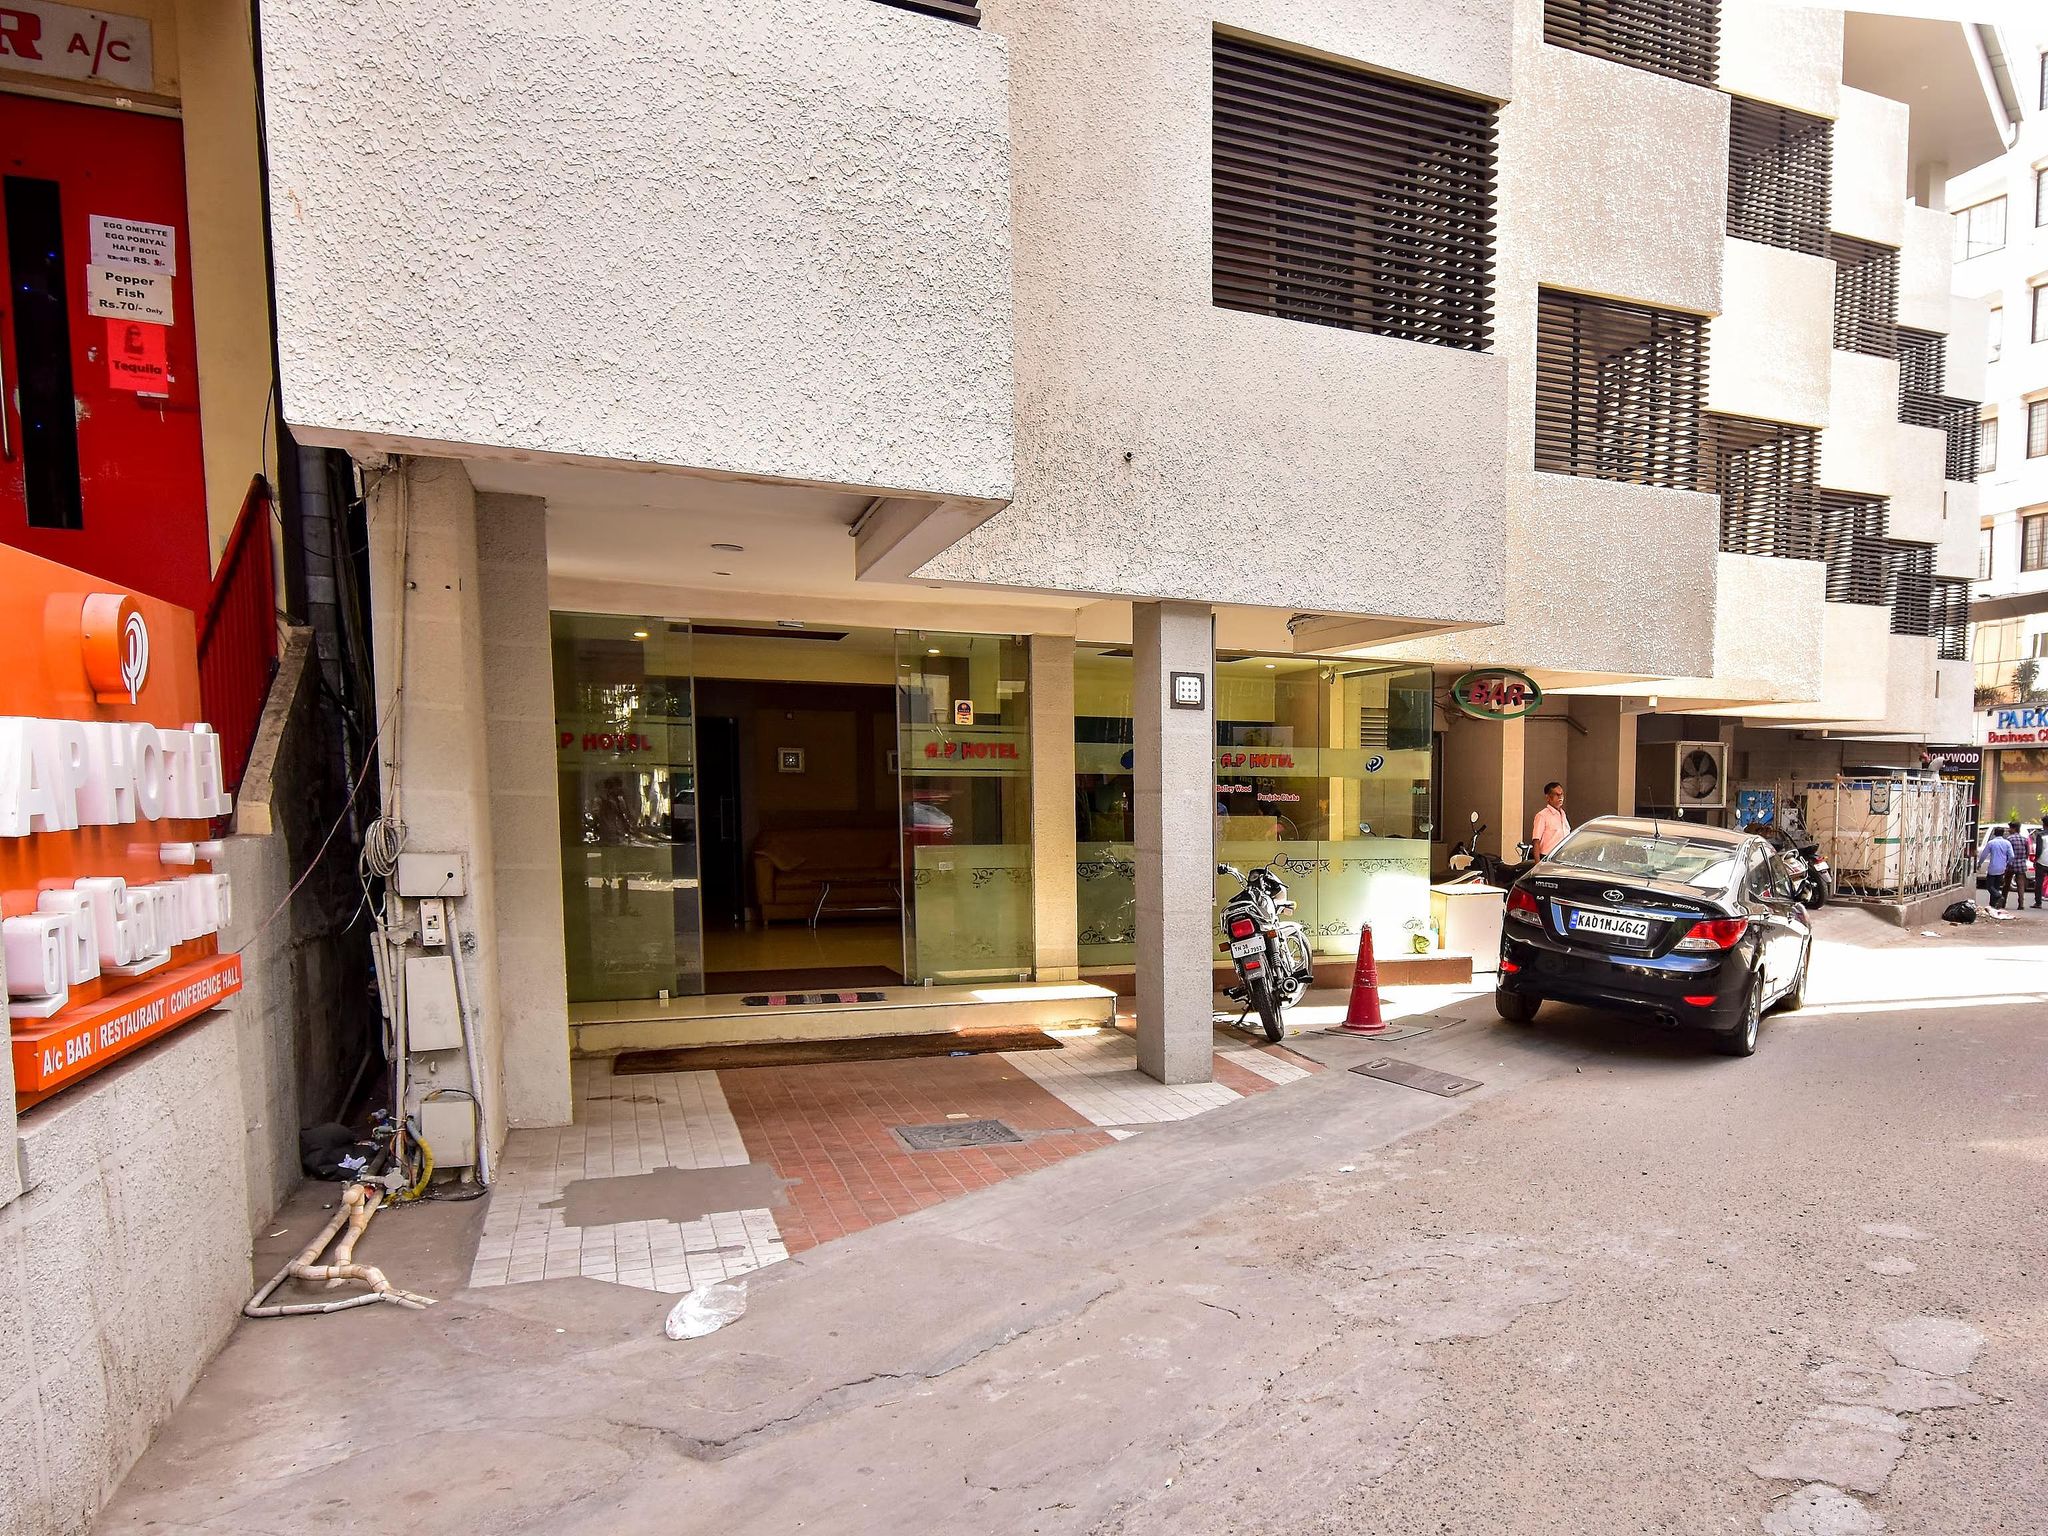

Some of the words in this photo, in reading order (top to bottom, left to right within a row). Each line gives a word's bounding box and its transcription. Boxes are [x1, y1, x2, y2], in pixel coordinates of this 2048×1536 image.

[66, 20, 132, 75] A/C
[103, 222, 122, 230] EGG
[125, 225, 168, 237] OMLETTE
[105, 232, 124, 241] EGG
[126, 236, 167, 247] PORIYAL
[112, 243, 137, 252] HALF
[139, 247, 160, 256] BOIL
[133, 256, 150, 265] RS.
[105, 272, 155, 286] Pepper
[116, 287, 145, 299] Fish
[99, 299, 142, 312] Rs.70/-
[145, 307, 163, 315] Only
[1470, 679, 1526, 706] BAR
[1988, 731, 2035, 743] Business
[961, 742, 1019, 760] HOTEL
[1221, 753, 1246, 768] A.P
[1250, 753, 1295, 768] HOTEL
[1671, 902, 1701, 912] VERNA
[43, 1046, 63, 1077] A/c
[66, 1032, 92, 1066] BAR
[100, 998, 165, 1049] RESTAURANT
[170, 975, 222, 1014] CONFERENCE
[222, 966, 240, 989] HALL
